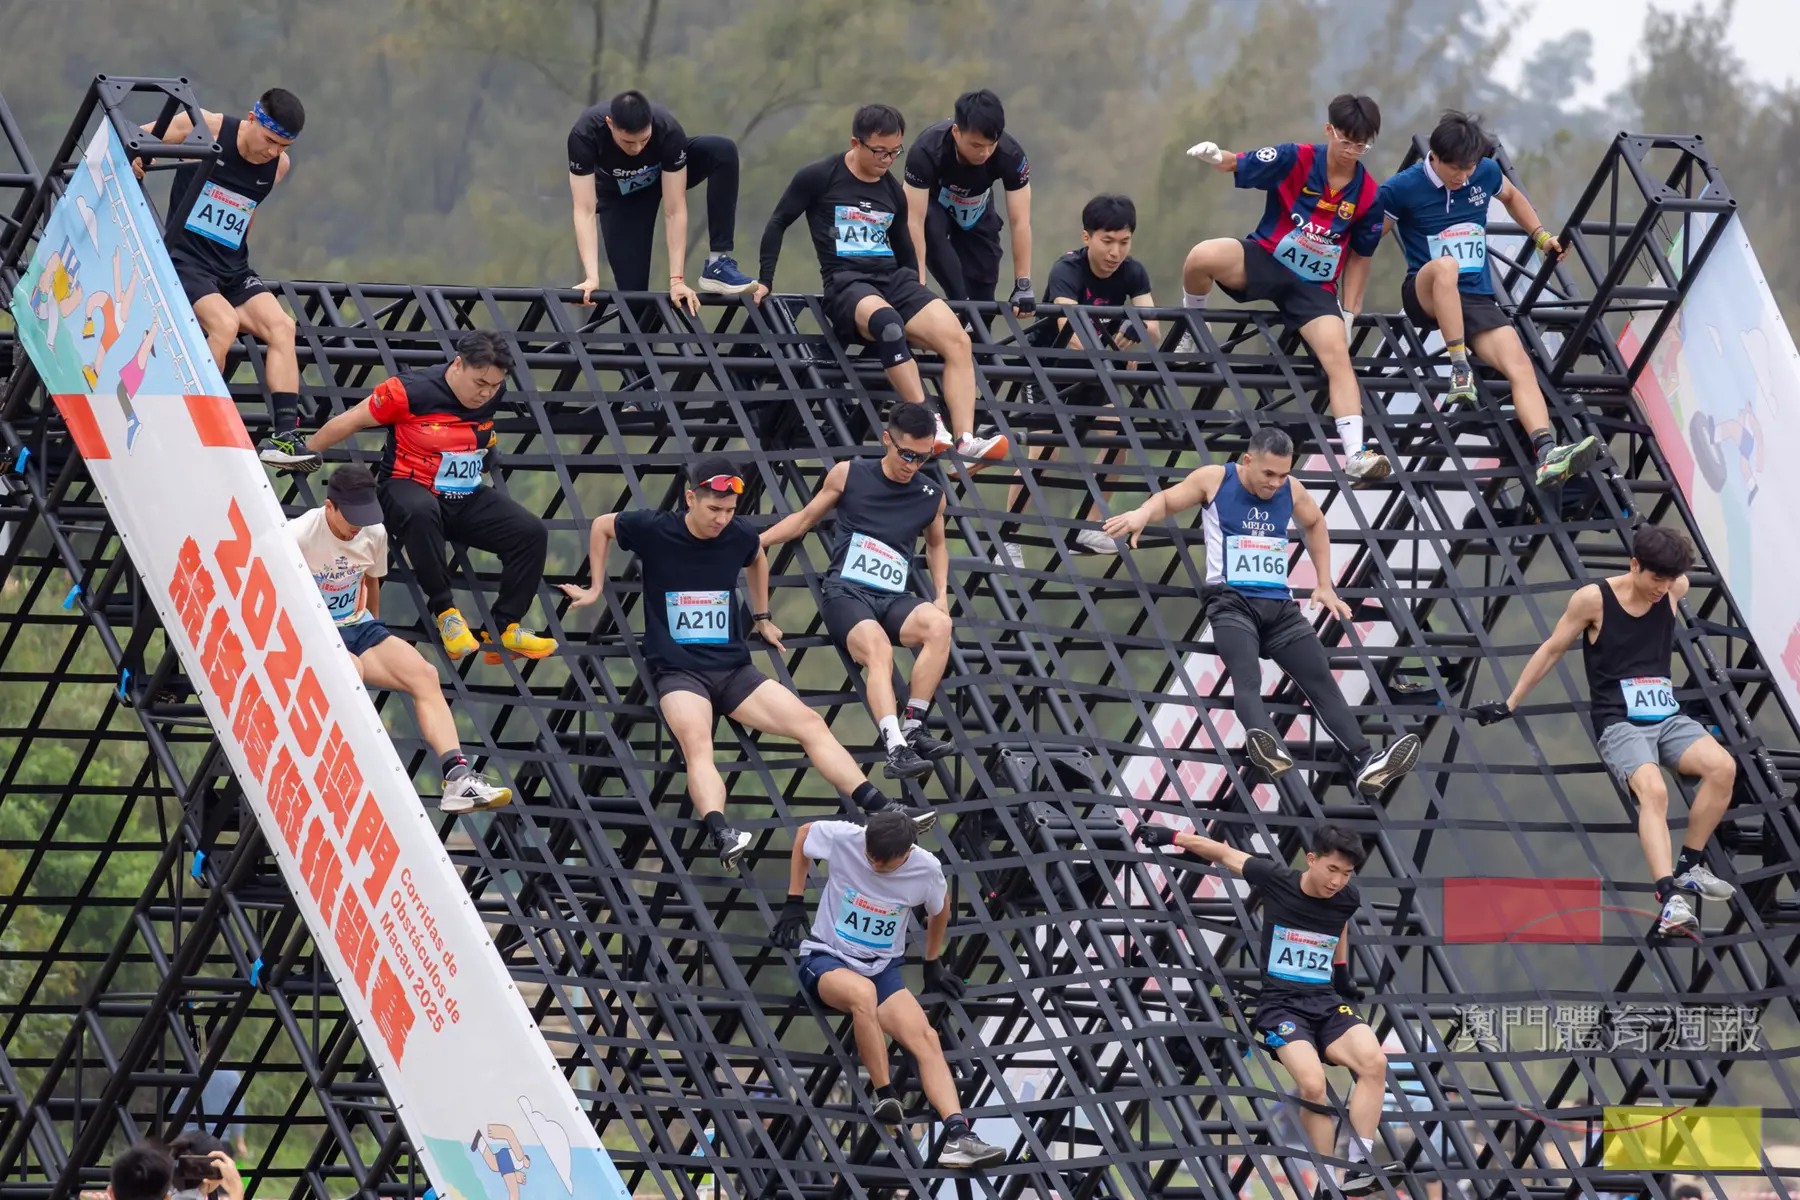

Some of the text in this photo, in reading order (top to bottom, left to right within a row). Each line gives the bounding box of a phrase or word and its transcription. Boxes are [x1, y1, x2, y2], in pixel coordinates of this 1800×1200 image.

[197, 203, 245, 236] A194
[1282, 247, 1333, 278] A143
[1440, 241, 1484, 260] A176
[1242, 520, 1276, 532] MELCO
[851, 554, 904, 585] A209
[1235, 554, 1285, 575] A166
[323, 588, 357, 610] 204
[676, 610, 726, 630] A210
[169, 536, 416, 1069] 競技障礙挑戰賽
[400, 867, 458, 978] Corridas de
[844, 911, 897, 937] A138
[390, 889, 461, 1024] Obstáculos de
[1277, 947, 1329, 972] A152
[379, 911, 445, 1033] Macau 2025
